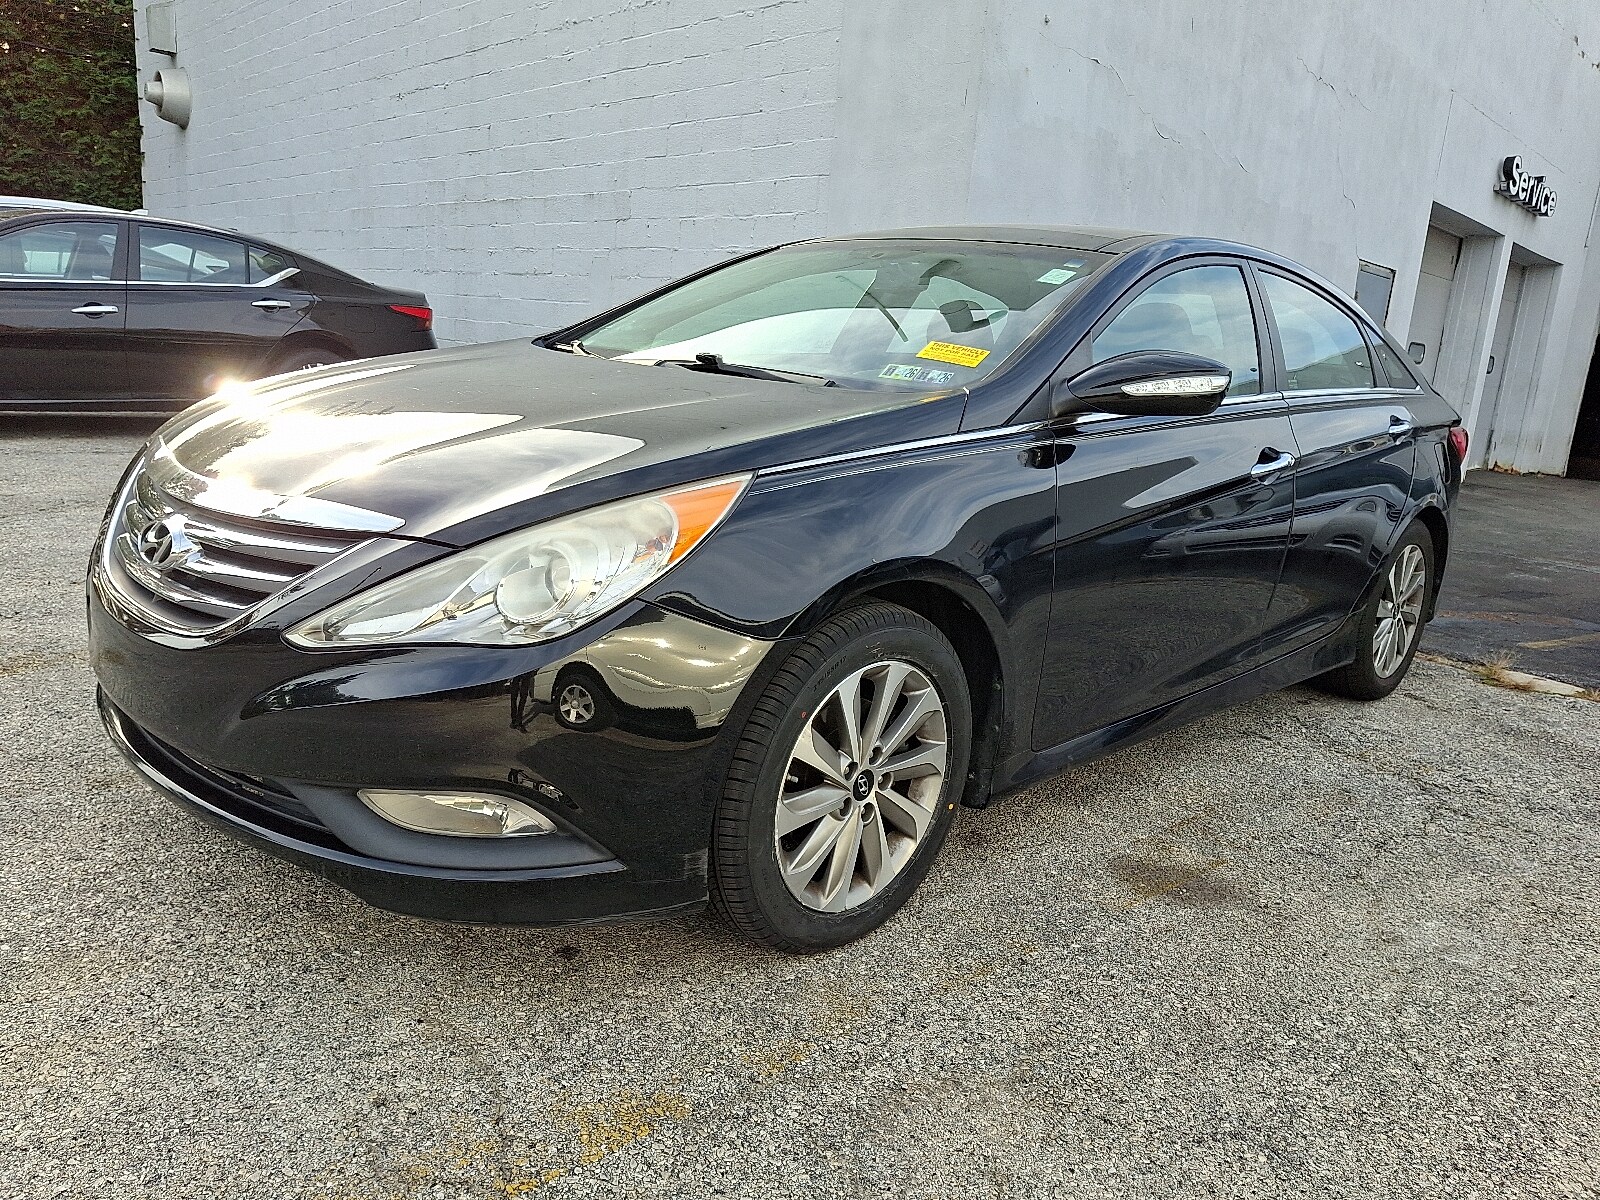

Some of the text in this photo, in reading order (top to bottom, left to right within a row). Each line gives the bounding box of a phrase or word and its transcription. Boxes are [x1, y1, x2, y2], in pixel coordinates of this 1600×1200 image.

[1507, 155, 1557, 217] Service
[951, 345, 987, 356] VEHICLE
[904, 368, 918, 379] 26
[938, 372, 953, 383] 26
